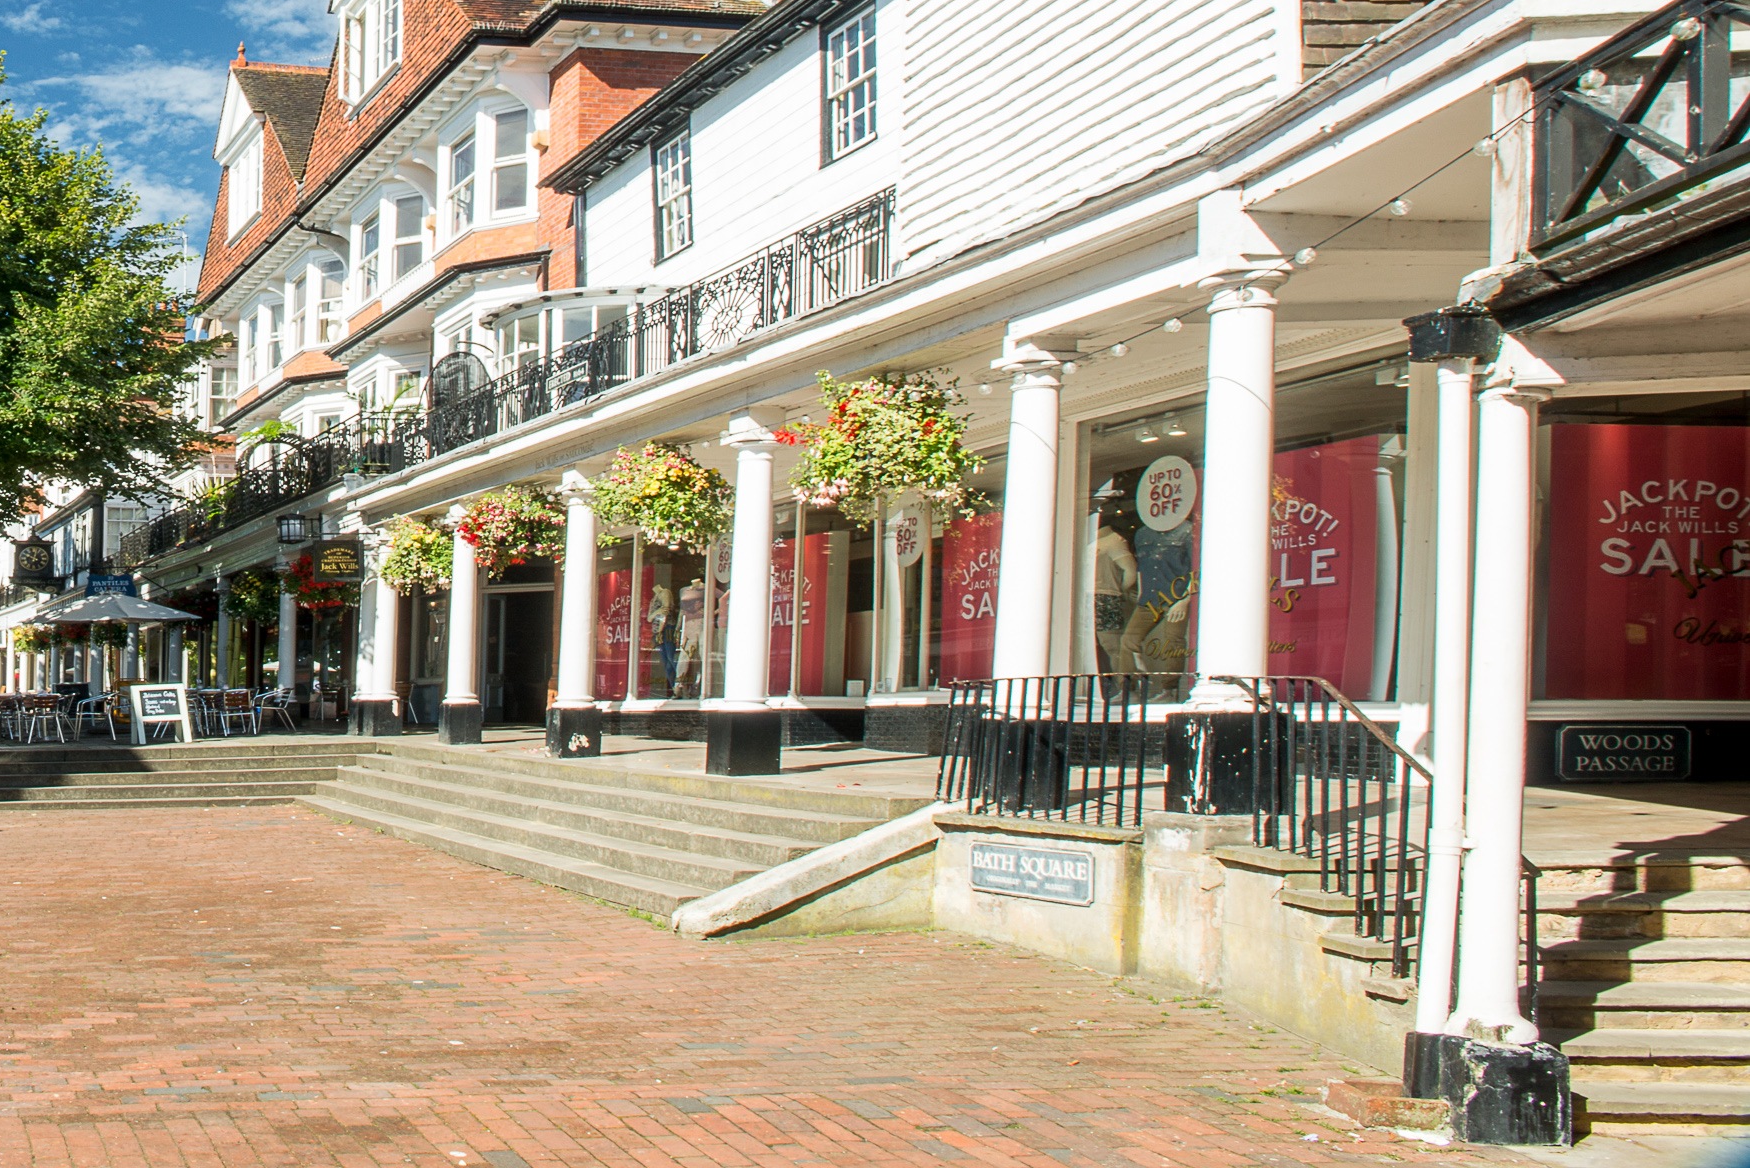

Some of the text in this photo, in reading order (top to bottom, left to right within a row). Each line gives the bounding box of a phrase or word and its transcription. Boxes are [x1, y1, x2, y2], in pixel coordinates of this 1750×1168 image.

[1149, 468, 1182, 485] UP TO
[1150, 483, 1182, 501] 60%
[1150, 498, 1182, 518] OFF
[1662, 506, 1700, 519] THE
[908, 517, 918, 527] TO
[1272, 499, 1339, 537] KPOT!
[896, 529, 917, 542] 60%
[1271, 524, 1290, 536] HE
[1617, 521, 1739, 534] JACK WILLS
[897, 541, 917, 556] OFF
[1272, 534, 1317, 550] WILLS
[718, 551, 730, 563] 60
[320, 563, 337, 571] Jack
[961, 548, 1000, 586] JACK
[987, 568, 999, 577] TH
[1280, 548, 1337, 588] LE
[968, 579, 991, 591] JACK
[606, 594, 632, 620] JACKP
[961, 591, 996, 620] SA
[770, 601, 810, 627] ALE
[605, 623, 631, 644] SAL
[1579, 735, 1675, 751] WOODS
[1576, 756, 1675, 772] PASSAGE
[972, 851, 1088, 881] BATH SQUARE
